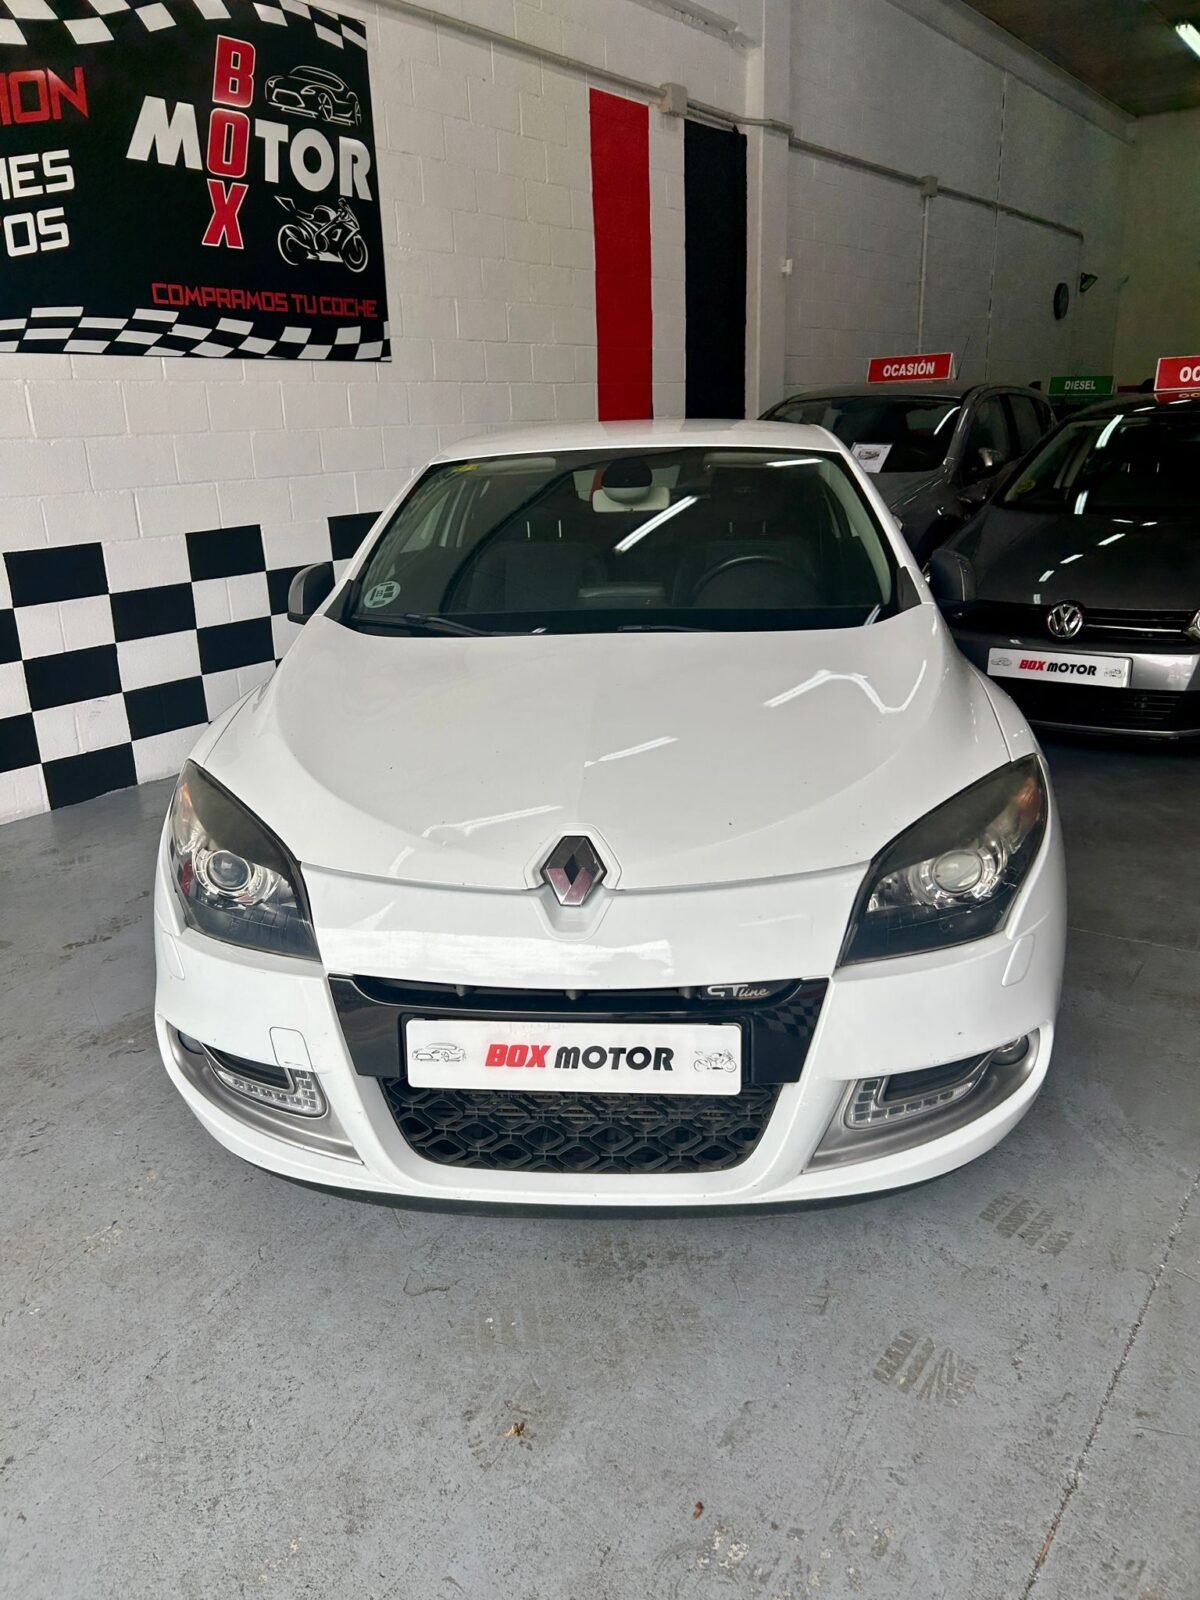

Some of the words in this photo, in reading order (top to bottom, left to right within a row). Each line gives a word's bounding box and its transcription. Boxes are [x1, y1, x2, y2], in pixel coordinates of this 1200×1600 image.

[202, 34, 256, 250] BOX
[152, 283, 288, 312] COMPRAMOS
[291, 294, 316, 314] TU
[320, 297, 378, 318] COCHE
[882, 360, 935, 377] OCASIÓN
[1064, 381, 1096, 390] DIESEL
[1019, 659, 1046, 671] BOX
[1046, 662, 1097, 676] MOTOR
[485, 1044, 551, 1067] BOX
[554, 1045, 674, 1071] MOTOR
